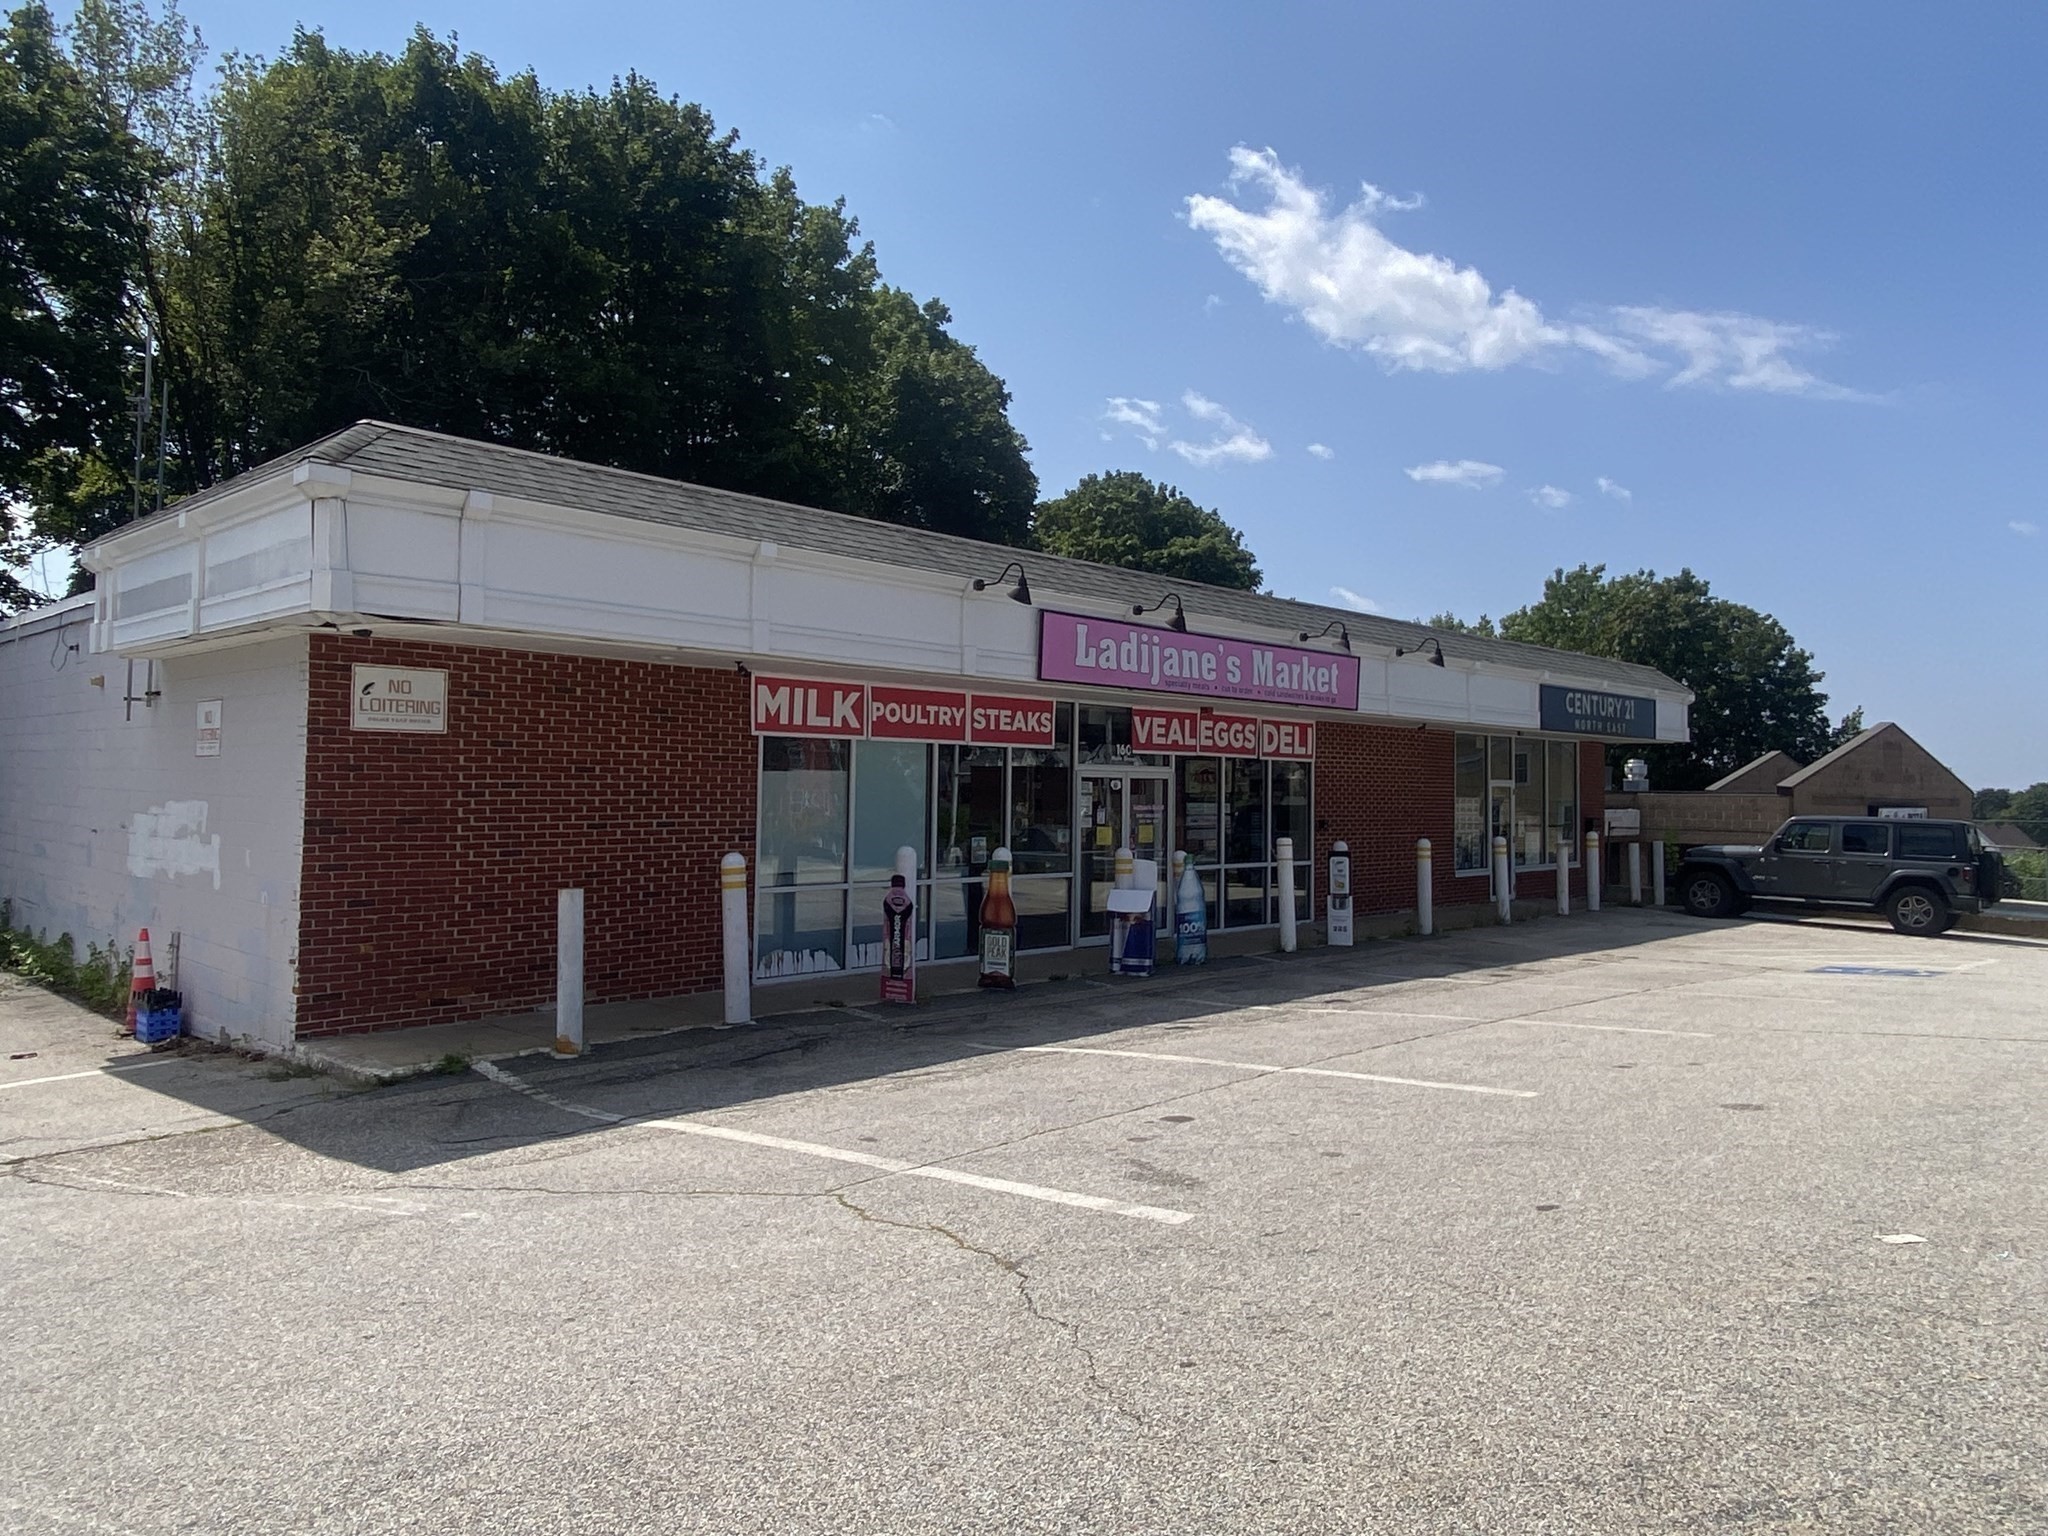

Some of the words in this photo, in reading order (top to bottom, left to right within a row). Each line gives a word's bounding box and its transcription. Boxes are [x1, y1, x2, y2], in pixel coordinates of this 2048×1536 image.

[1075, 623, 1241, 685] Ladijane's
[1252, 649, 1339, 695] Market
[388, 679, 412, 695] NO
[359, 697, 441, 715] LOITERING
[757, 684, 861, 729] MILK
[871, 701, 965, 727] POULTRY
[1565, 692, 1623, 718] CENTURY
[1624, 699, 1635, 720] 21
[972, 707, 1052, 734] STEAKS
[1132, 715, 1197, 745] VEAL
[1574, 719, 1602, 732] NORTH
[1606, 721, 1627, 734] EAST
[1200, 720, 1256, 749] EGGS
[1263, 723, 1312, 755] DELI
[1116, 743, 1132, 756] 160
